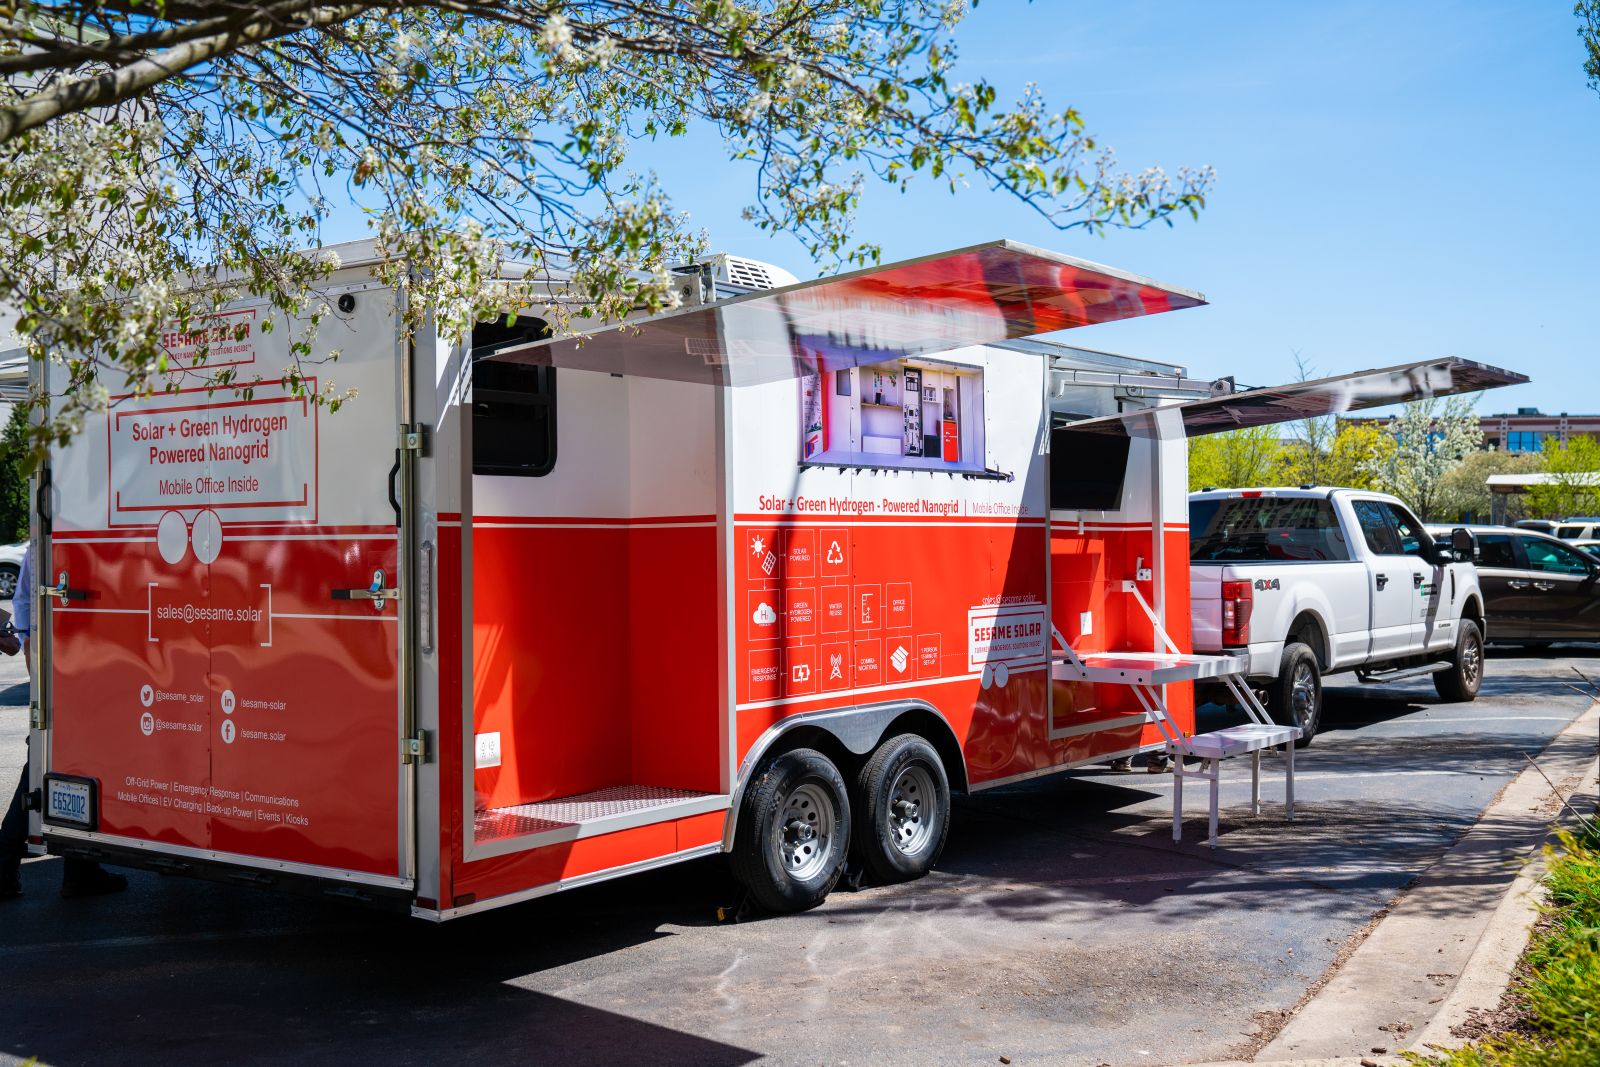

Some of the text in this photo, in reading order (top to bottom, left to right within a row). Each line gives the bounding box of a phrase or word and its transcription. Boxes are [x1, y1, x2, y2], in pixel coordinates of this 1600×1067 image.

[132, 422, 165, 441] Solar
[180, 418, 218, 438] Green
[222, 414, 288, 439] Hydrogen
[150, 439, 269, 465] Powered Nanogrid
[159, 475, 259, 495] Mobile Office Inside
[759, 494, 786, 511] Solar
[797, 496, 827, 512] Green
[829, 496, 875, 515] Hydrogen
[882, 498, 920, 513] Powered
[922, 499, 959, 516] Nanogrid
[972, 502, 992, 514] Mobile
[994, 502, 1011, 515] Office
[1012, 503, 1029, 515] Inside
[157, 603, 263, 624] sales@sesame.solar
[790, 608, 812, 616] HYDROGEN
[790, 615, 811, 623] POWERED
[974, 622, 1041, 642] SESAME SOLAR
[751, 666, 779, 675] EMERGENCY
[752, 673, 777, 682] RESPONSE
[156, 690, 205, 704] @sesame_solar
[240, 698, 287, 710] /sesame-solar
[155, 719, 202, 732] @sesame.solar
[240, 728, 287, 741] /sesame.solar
[125, 776, 149, 788] Off-Grid
[150, 779, 169, 790] Power
[173, 782, 209, 797] Emergency
[209, 786, 240, 799] Response
[244, 791, 299, 808] Communications
[117, 791, 138, 803] Mobile
[138, 793, 159, 805] Offices
[163, 796, 173, 807] EV
[173, 798, 203, 812] Charging
[206, 803, 231, 816] Back-up
[232, 806, 253, 818] Power
[257, 809, 281, 822] Events
[285, 813, 309, 826] Kiosks
